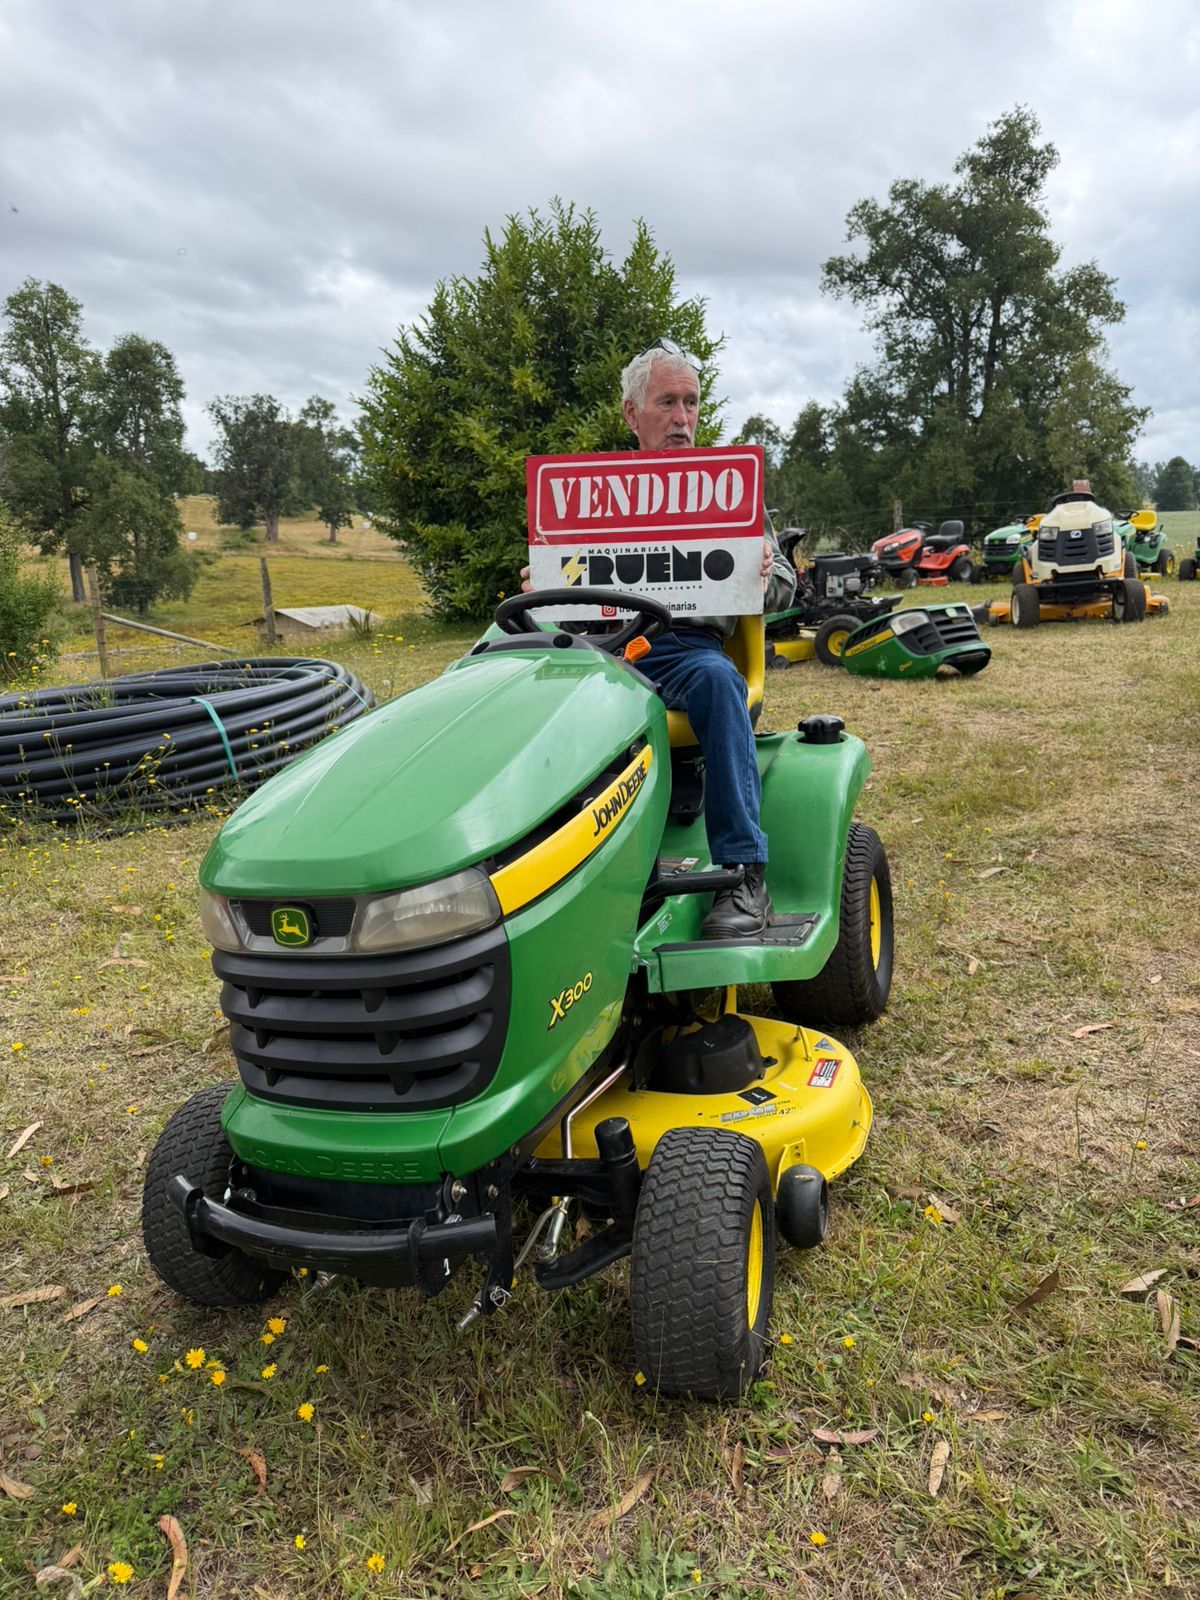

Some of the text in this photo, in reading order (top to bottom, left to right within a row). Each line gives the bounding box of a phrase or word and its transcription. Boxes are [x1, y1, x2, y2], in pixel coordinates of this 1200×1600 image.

[549, 468, 744, 519] VENDIDO
[560, 545, 735, 587] TRUENO
[588, 545, 667, 555] MAQUINARIAS
[593, 760, 647, 837] JOHN DEERE
[547, 971, 593, 1030] X300
[316, 1155, 423, 1180] DEERE
